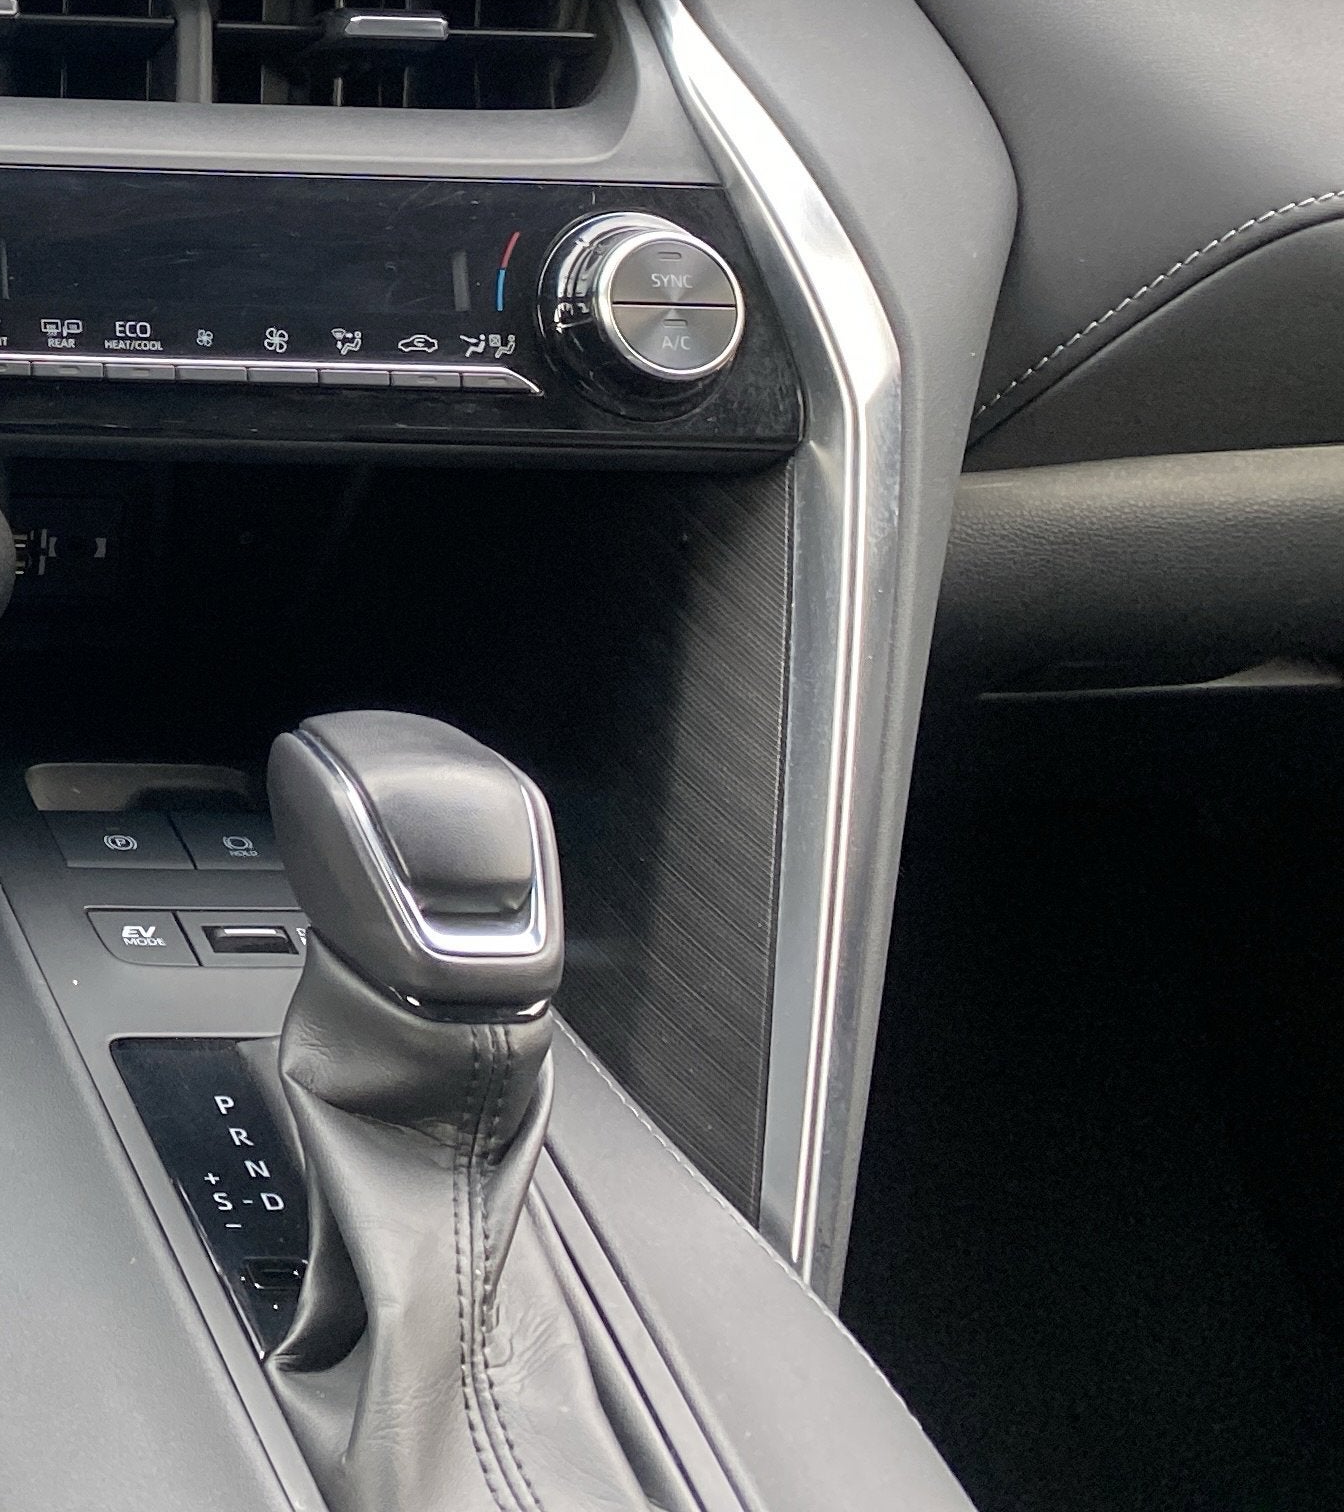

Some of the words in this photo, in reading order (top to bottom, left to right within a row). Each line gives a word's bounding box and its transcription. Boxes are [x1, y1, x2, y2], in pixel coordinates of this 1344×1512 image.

[650, 272, 693, 289] SYNC
[114, 321, 151, 339] ECO
[47, 337, 76, 349] REAR
[104, 340, 164, 351] HEAT/COOL
[661, 334, 691, 351] A/C
[229, 849, 259, 858] HOLD
[121, 925, 156, 939] EV
[123, 937, 167, 947] MODE
[213, 1094, 235, 1115] P
[228, 1127, 255, 1147] R
[244, 1160, 271, 1179] N
[212, 1192, 234, 1211] S
[260, 1192, 285, 1211] D
